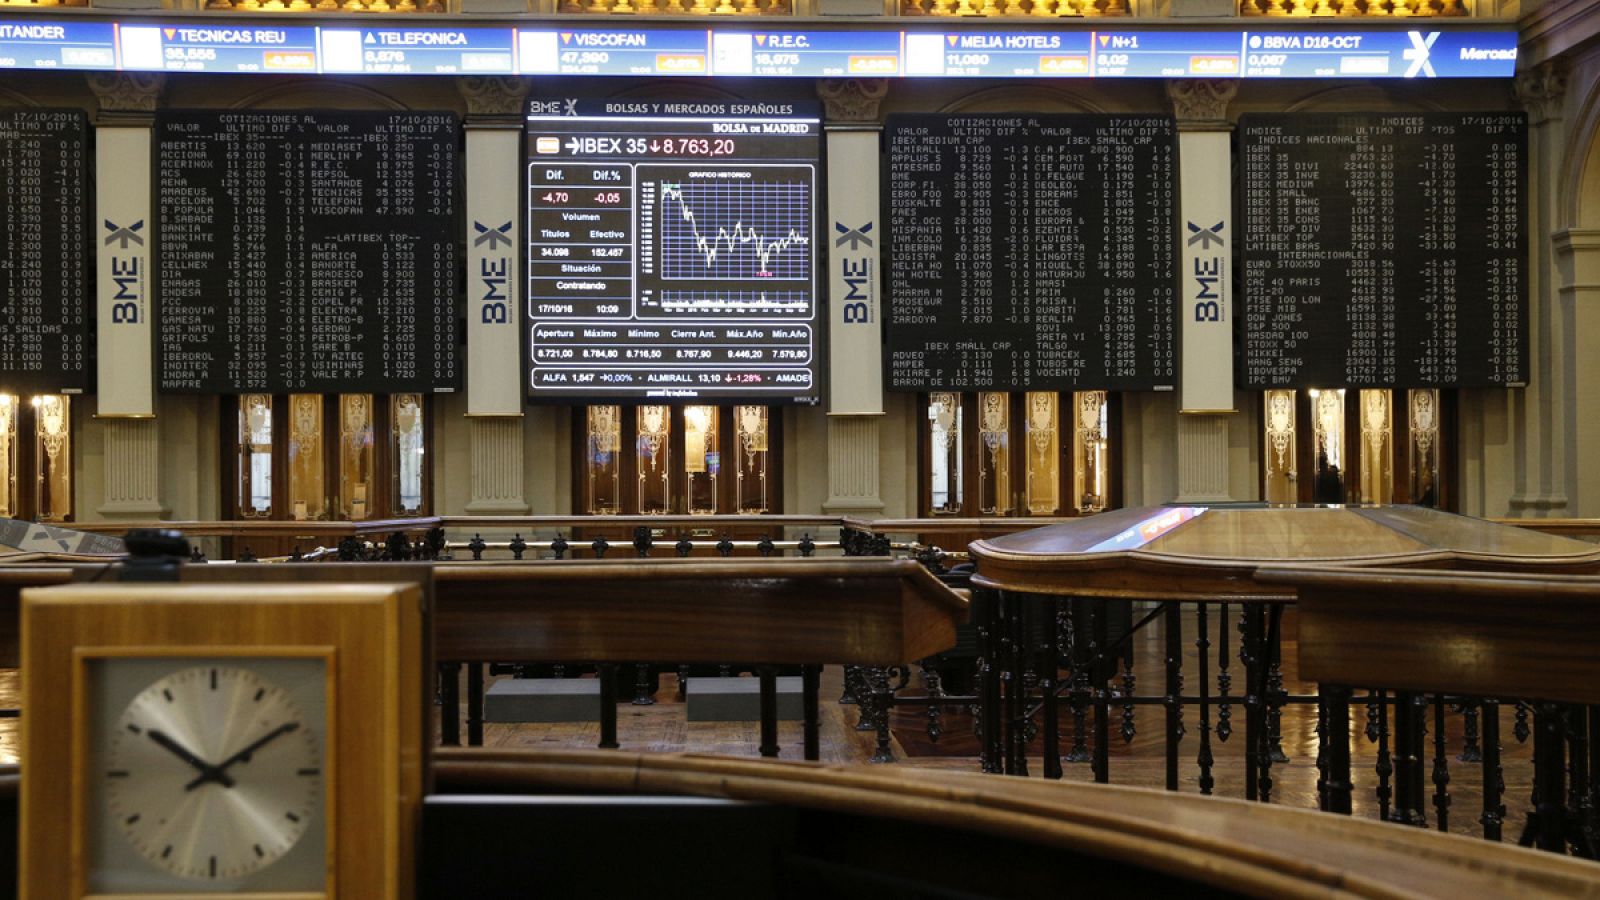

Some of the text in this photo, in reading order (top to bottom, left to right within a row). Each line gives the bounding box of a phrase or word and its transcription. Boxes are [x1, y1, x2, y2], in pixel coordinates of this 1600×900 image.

[178, 29, 285, 43] TECNICAS REU
[378, 32, 467, 45] TELEFONICA
[575, 34, 646, 46] VISCOFAN
[769, 36, 809, 48] R.E.C.
[961, 36, 1060, 48] MELIA HOTELS
[1112, 36, 1138, 48] N+1
[1263, 36, 1362, 48] BBVA D16-OCT
[530, 101, 560, 113] BME
[606, 102, 793, 114] BOLSAS Y MERCADOS ESPAÑOLES
[14, 112, 80, 120] 17/10/2016
[220, 115, 298, 123] COTIZACIONES
[388, 116, 452, 124] 17/10/2016
[947, 119, 1022, 127] COTIZACIONES
[1382, 117, 1424, 126] INDICES
[1462, 117, 1523, 125] 17/10/2016
[47, 122, 66, 130] DIF
[167, 124, 200, 132] VALOR
[226, 124, 265, 132] ULTIMO
[376, 125, 414, 133] ULTIMO
[713, 123, 748, 133] BOLSA
[763, 124, 808, 133] MADRID
[897, 128, 1015, 136] VALOR ULTIMO DIF
[1041, 128, 1158, 136] VALOR ULTIMO DIF
[1356, 127, 1393, 135] ULTIMO
[892, 136, 984, 145] IBEX MEDIUM CAP
[1096, 137, 1153, 145] SMALL CAP
[1259, 136, 1368, 144] INDICES NACIONALES
[161, 142, 207, 150] ABERTIS
[311, 143, 362, 151] MEDIASET
[580, 138, 648, 153] IBEX 35
[663, 138, 734, 156] 8.763,20
[311, 170, 349, 179] REPSOL
[546, 170, 564, 180] Dif.
[592, 170, 620, 180] Dif.%
[542, 192, 569, 204] -4,70
[594, 193, 620, 204] -0,05
[562, 213, 600, 221] Volumen
[590, 230, 624, 238] Efectivo
[892, 253, 936, 261] LOGISTA
[1278, 251, 1369, 259] INTERNACIONALES
[560, 264, 602, 272] Situación
[311, 270, 363, 278] BRADESCO
[556, 280, 606, 290] Contratando
[1194, 257, 1218, 322] BME
[112, 256, 138, 324] BME
[482, 258, 505, 324] BME
[844, 258, 868, 323] BME
[1246, 288, 1284, 296] PSI-20
[596, 304, 619, 313] 10:09
[892, 306, 924, 315] SACYR
[16, 325, 62, 333] SALIDAS
[536, 329, 574, 338] Apertura
[584, 328, 618, 338] Máximo
[671, 330, 716, 338] Cierre Ant.
[955, 342, 1011, 350] SMALL CAP
[312, 371, 338, 379] VALE
[542, 374, 567, 382] ALFA
[648, 374, 692, 382] ALMIRALL
[698, 374, 721, 383] 13,10
